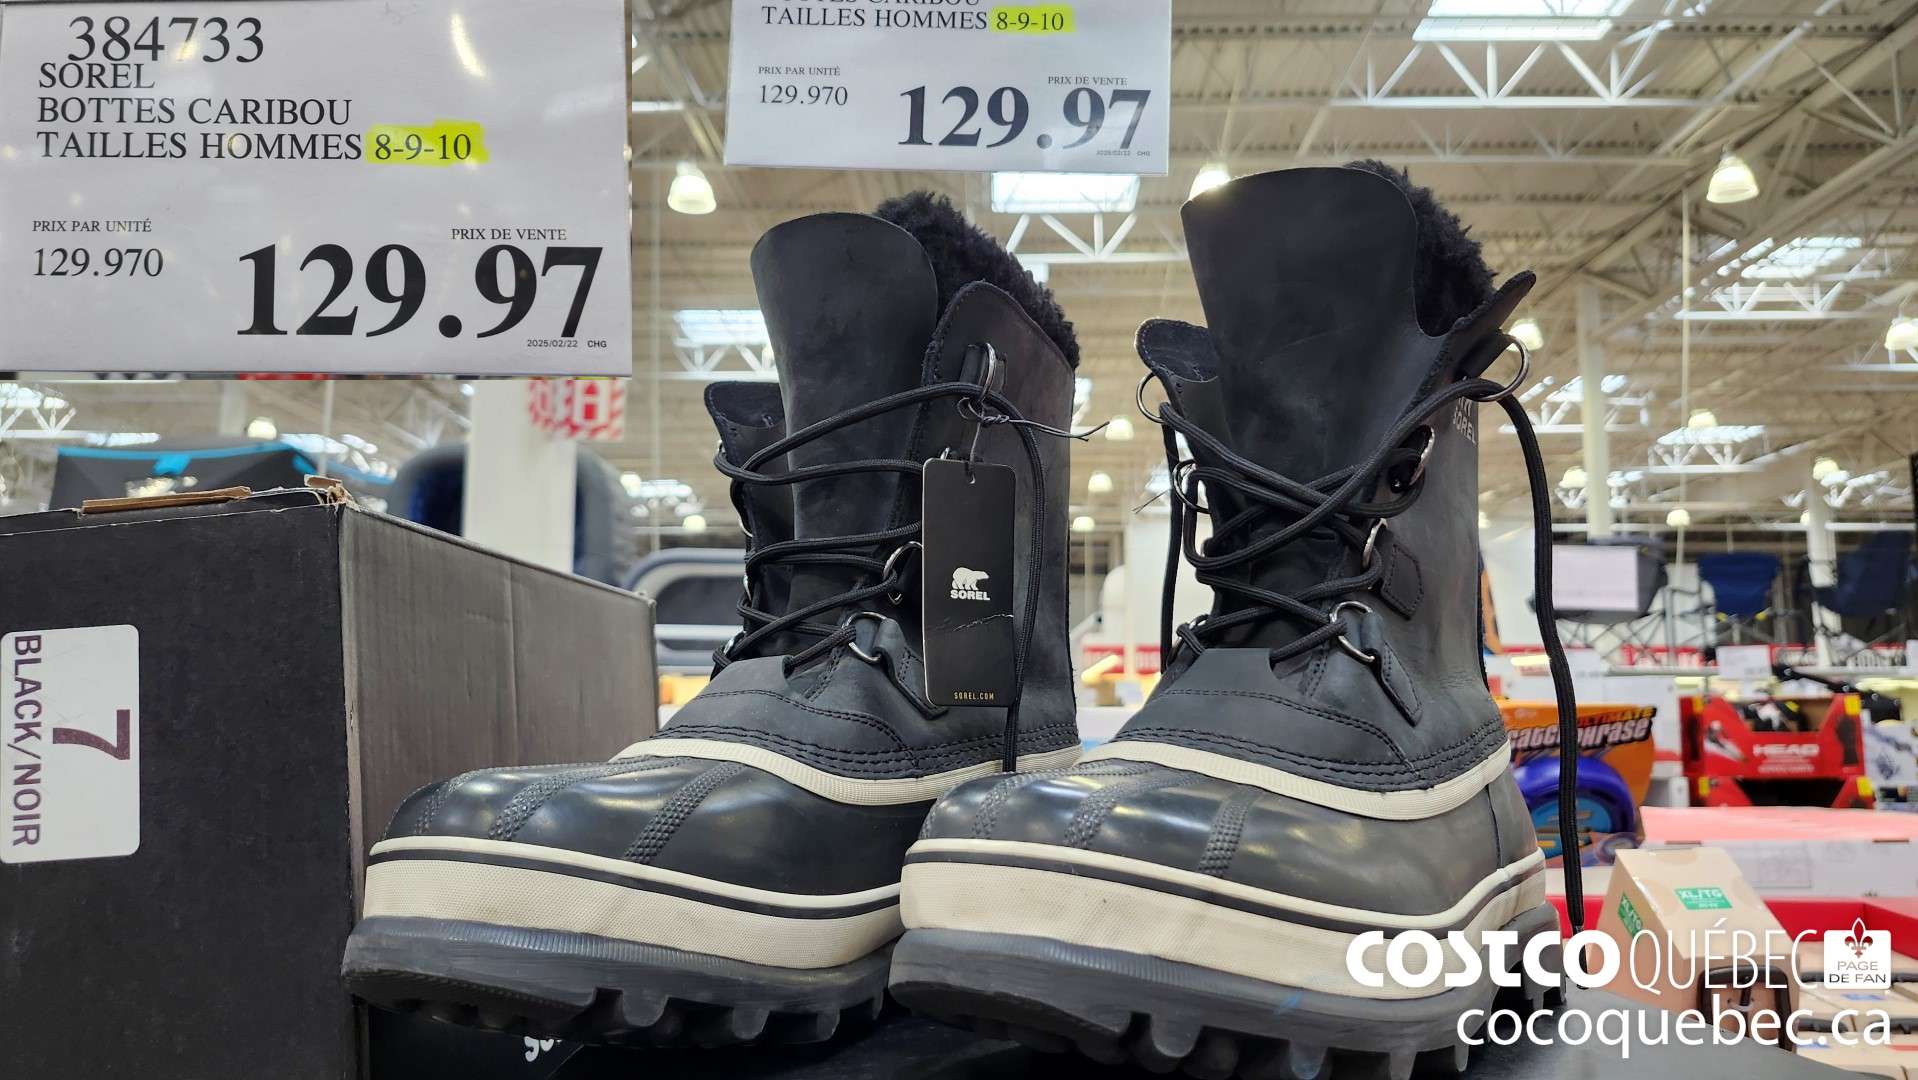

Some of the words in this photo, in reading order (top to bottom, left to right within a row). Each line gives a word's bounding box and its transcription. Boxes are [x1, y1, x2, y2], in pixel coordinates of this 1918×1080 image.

[762, 6, 865, 27] TAILLES
[875, 9, 988, 30] HOMMES
[996, 12, 1064, 31] 8-9-10
[66, 16, 265, 63] 384733
[38, 61, 155, 90] SOREL
[758, 65, 782, 76] PRIX
[785, 66, 806, 76] PAR
[1047, 75, 1072, 85] PRIX
[1075, 75, 1090, 86] DE
[1092, 76, 1128, 86] VENTE
[759, 84, 849, 106] 129.970
[37, 96, 176, 124] BOTTES
[187, 98, 352, 126] CARIBOU
[898, 85, 1152, 150] 129.97
[36, 131, 187, 159] TAILLES
[200, 132, 362, 161] HOMMES
[374, 133, 472, 161] 8-9-10
[32, 220, 67, 232] PRIX
[71, 221, 101, 232] PAR
[105, 218, 152, 233] UNITÉ
[451, 228, 486, 240] PRIX
[490, 229, 512, 240] DE
[516, 229, 567, 241] VENTE
[33, 247, 164, 277] 129.970
[237, 243, 604, 340] 129.97
[526, 339, 578, 348] 2025/02/22
[587, 339, 607, 348] CHG
[950, 589, 990, 600] SOREL
[954, 692, 994, 700] SOREL.COM
[7, 634, 43, 846] BLACK/NOIR
[53, 709, 131, 761] 7
